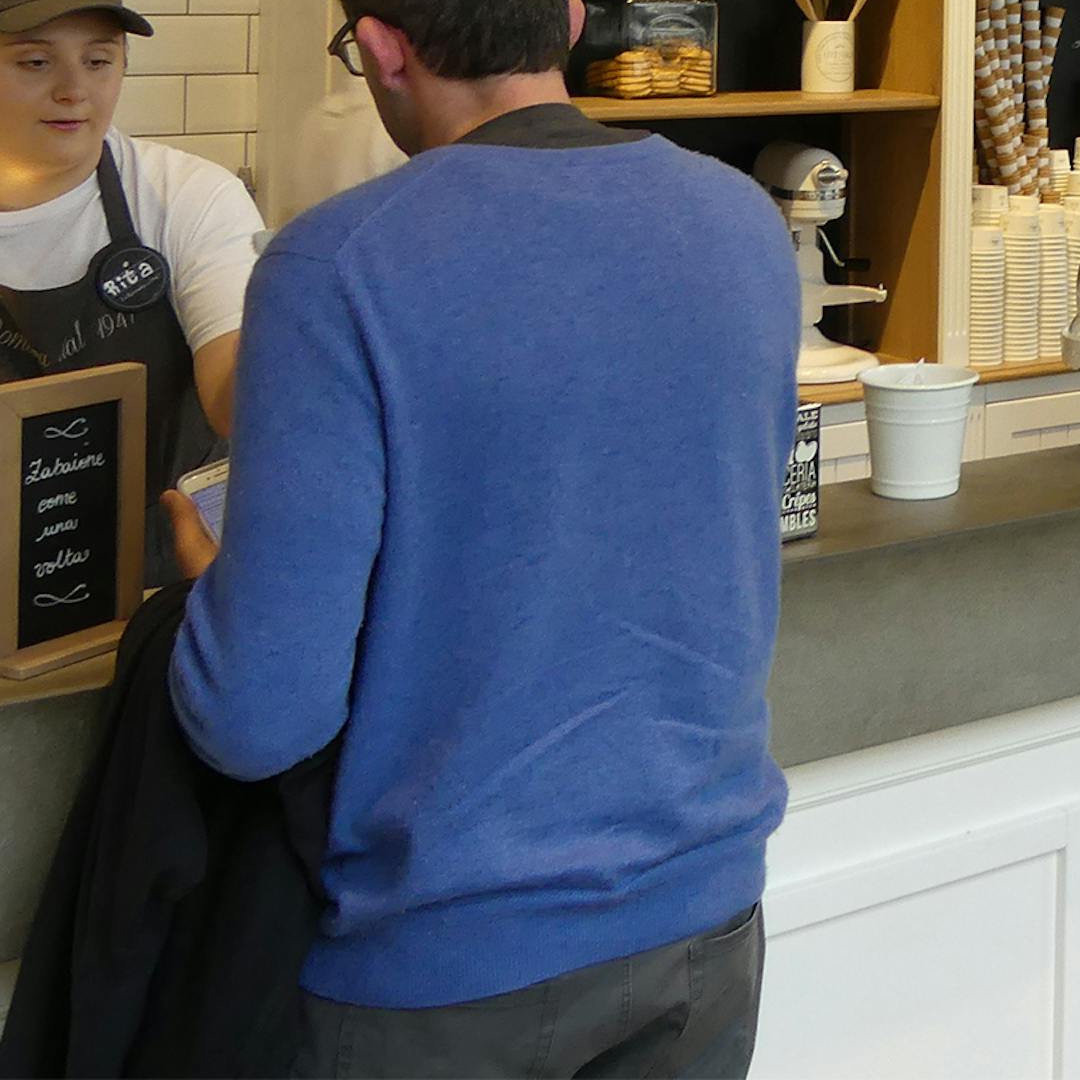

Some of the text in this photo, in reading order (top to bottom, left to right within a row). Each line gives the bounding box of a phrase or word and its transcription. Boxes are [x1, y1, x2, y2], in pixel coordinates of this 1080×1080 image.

[103, 261, 154, 296] Rita
[25, 450, 106, 486] Zabaione
[37, 489, 79, 515] come
[35, 518, 79, 543] una
[33, 547, 91, 578] volta
